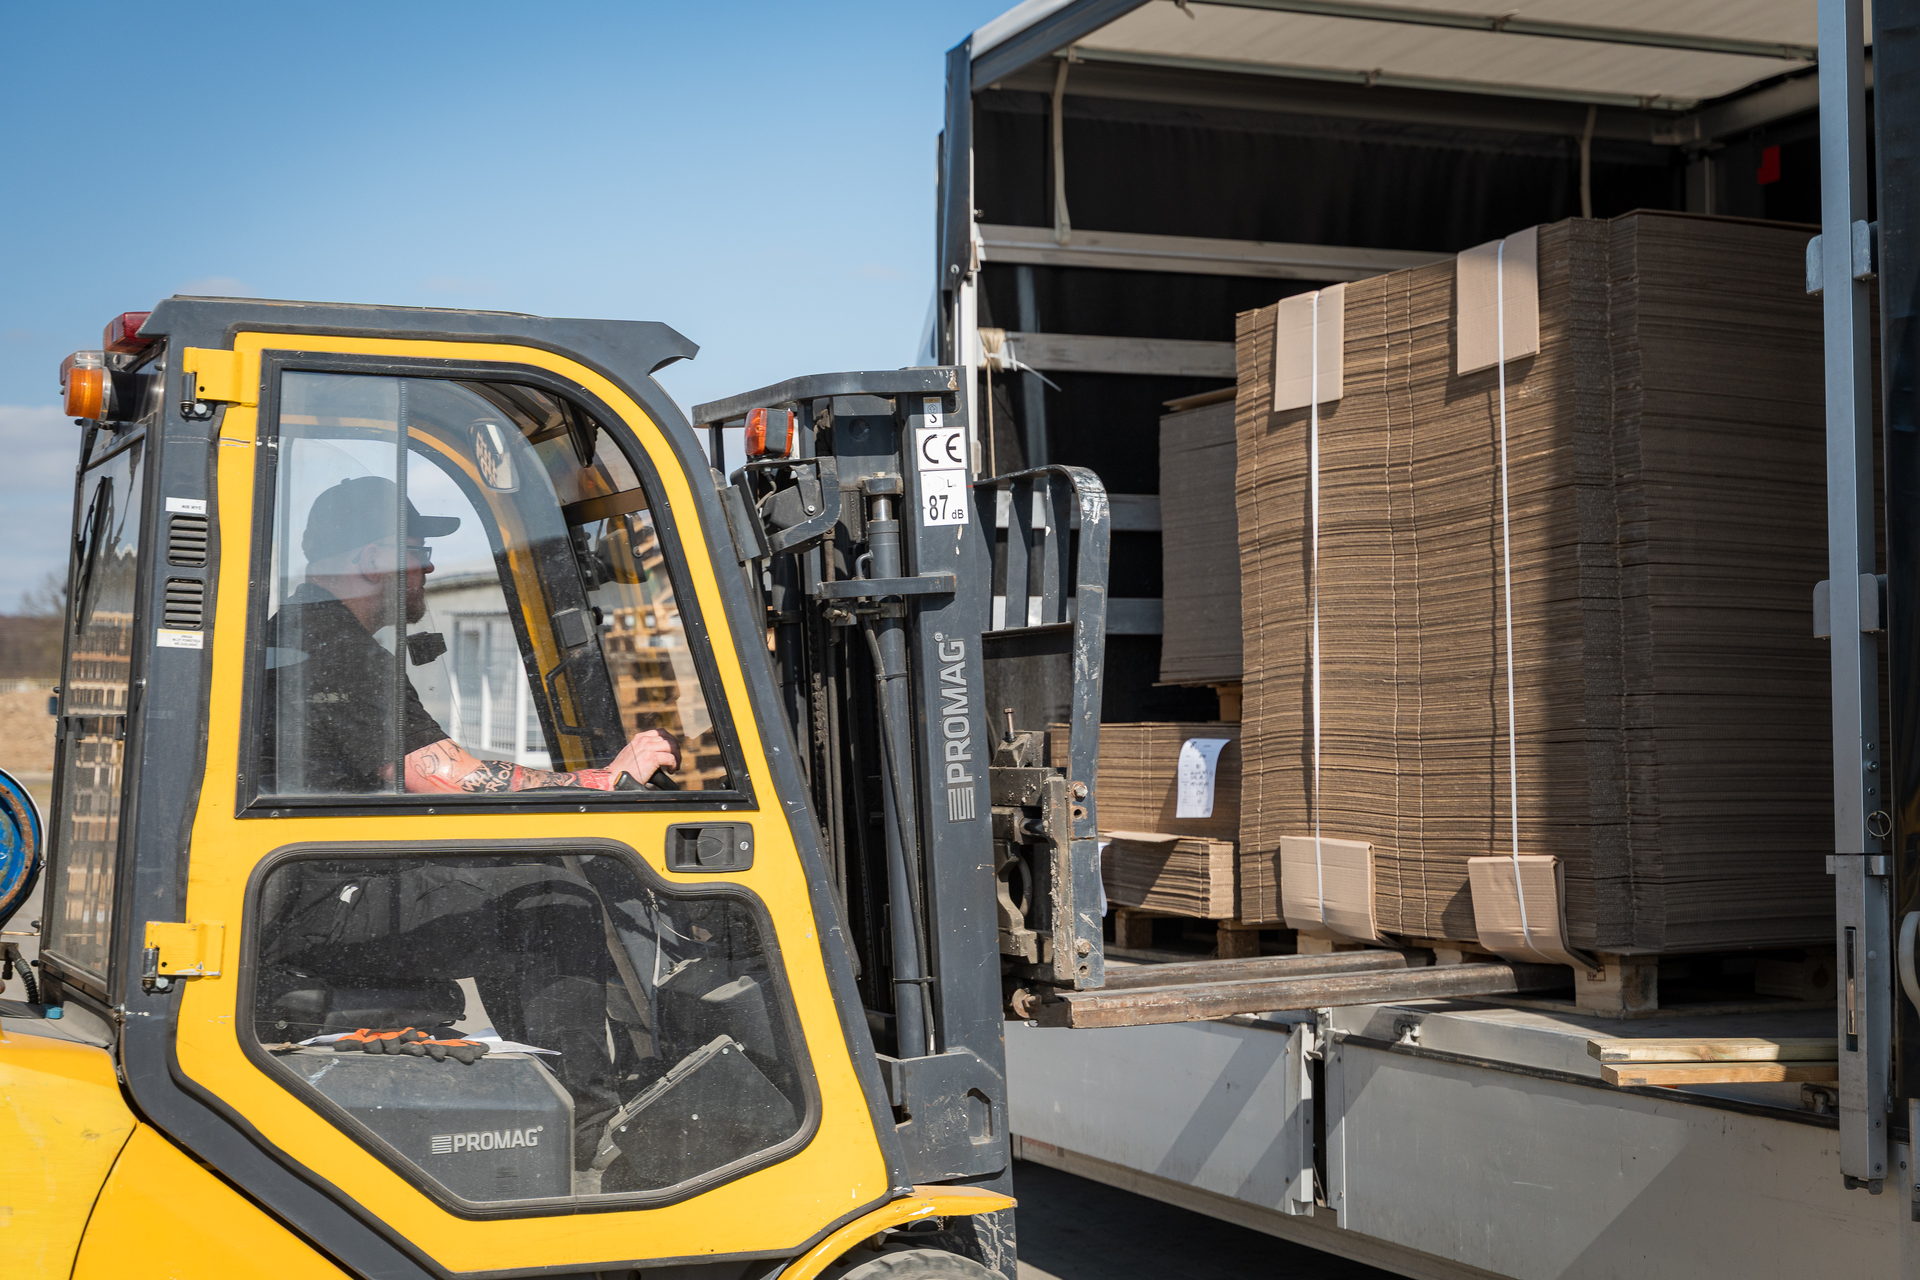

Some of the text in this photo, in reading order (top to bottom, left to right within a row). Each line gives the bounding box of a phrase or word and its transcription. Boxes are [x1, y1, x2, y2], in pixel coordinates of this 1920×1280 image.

[922, 432, 962, 464] CE
[928, 494, 964, 521] 87 dB
